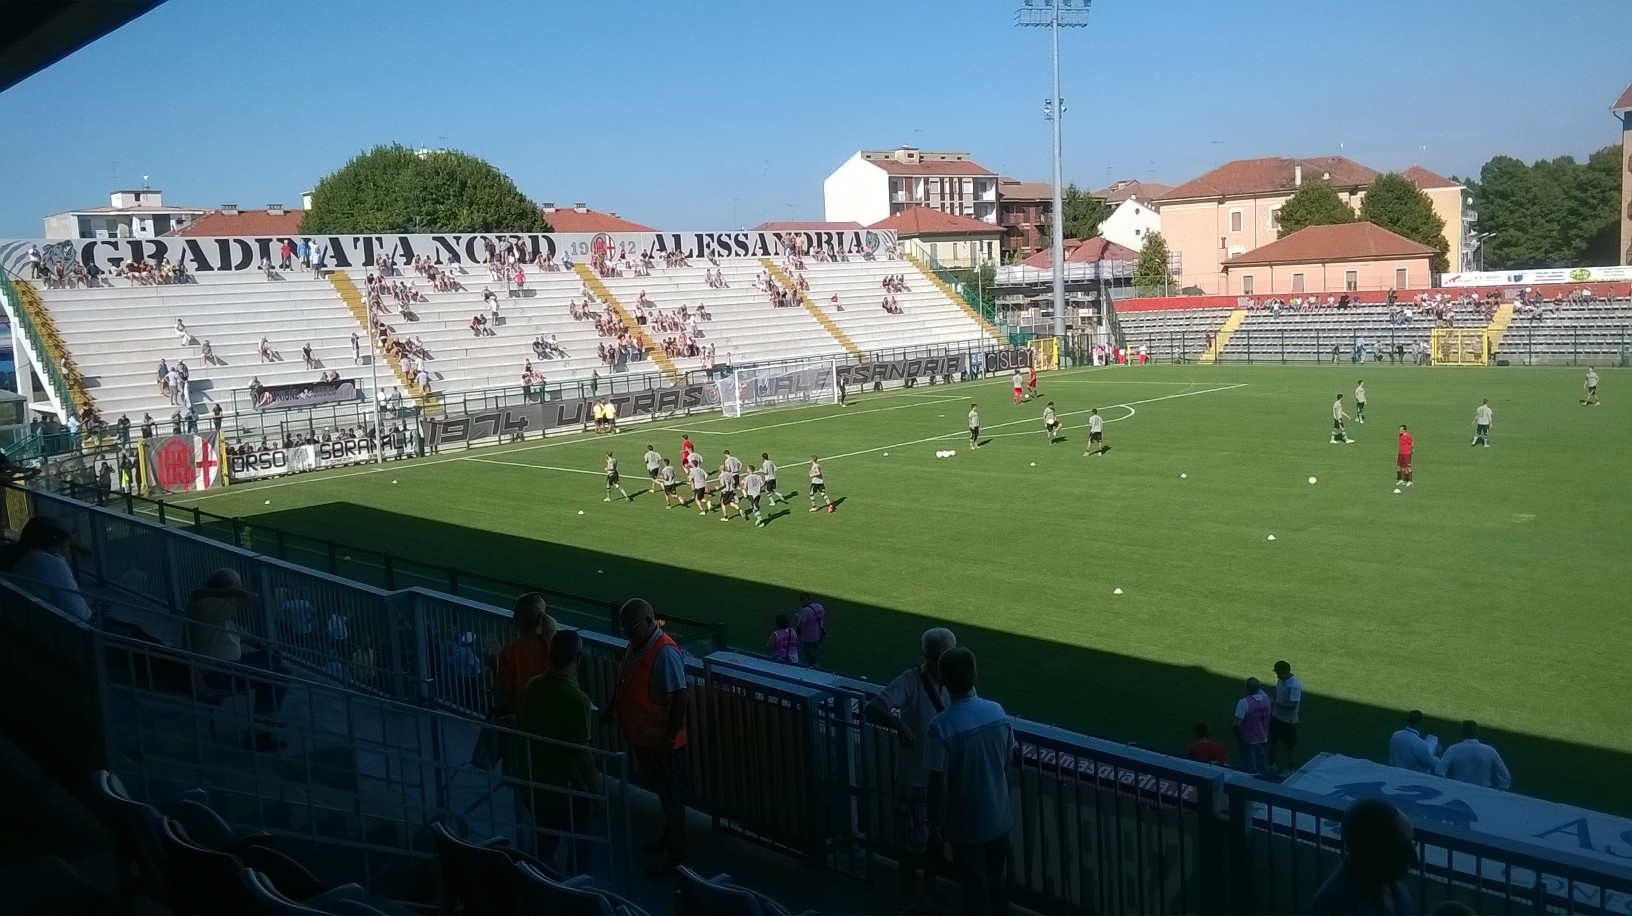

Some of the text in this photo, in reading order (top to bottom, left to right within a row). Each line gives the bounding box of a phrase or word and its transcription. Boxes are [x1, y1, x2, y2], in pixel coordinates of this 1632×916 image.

[81, 236, 417, 275] GRADINATA
[650, 231, 863, 259] ALESSANDRIA
[428, 411, 529, 445] 1974
[557, 386, 704, 427] ULTRAS
[232, 450, 286, 473] ORSO
